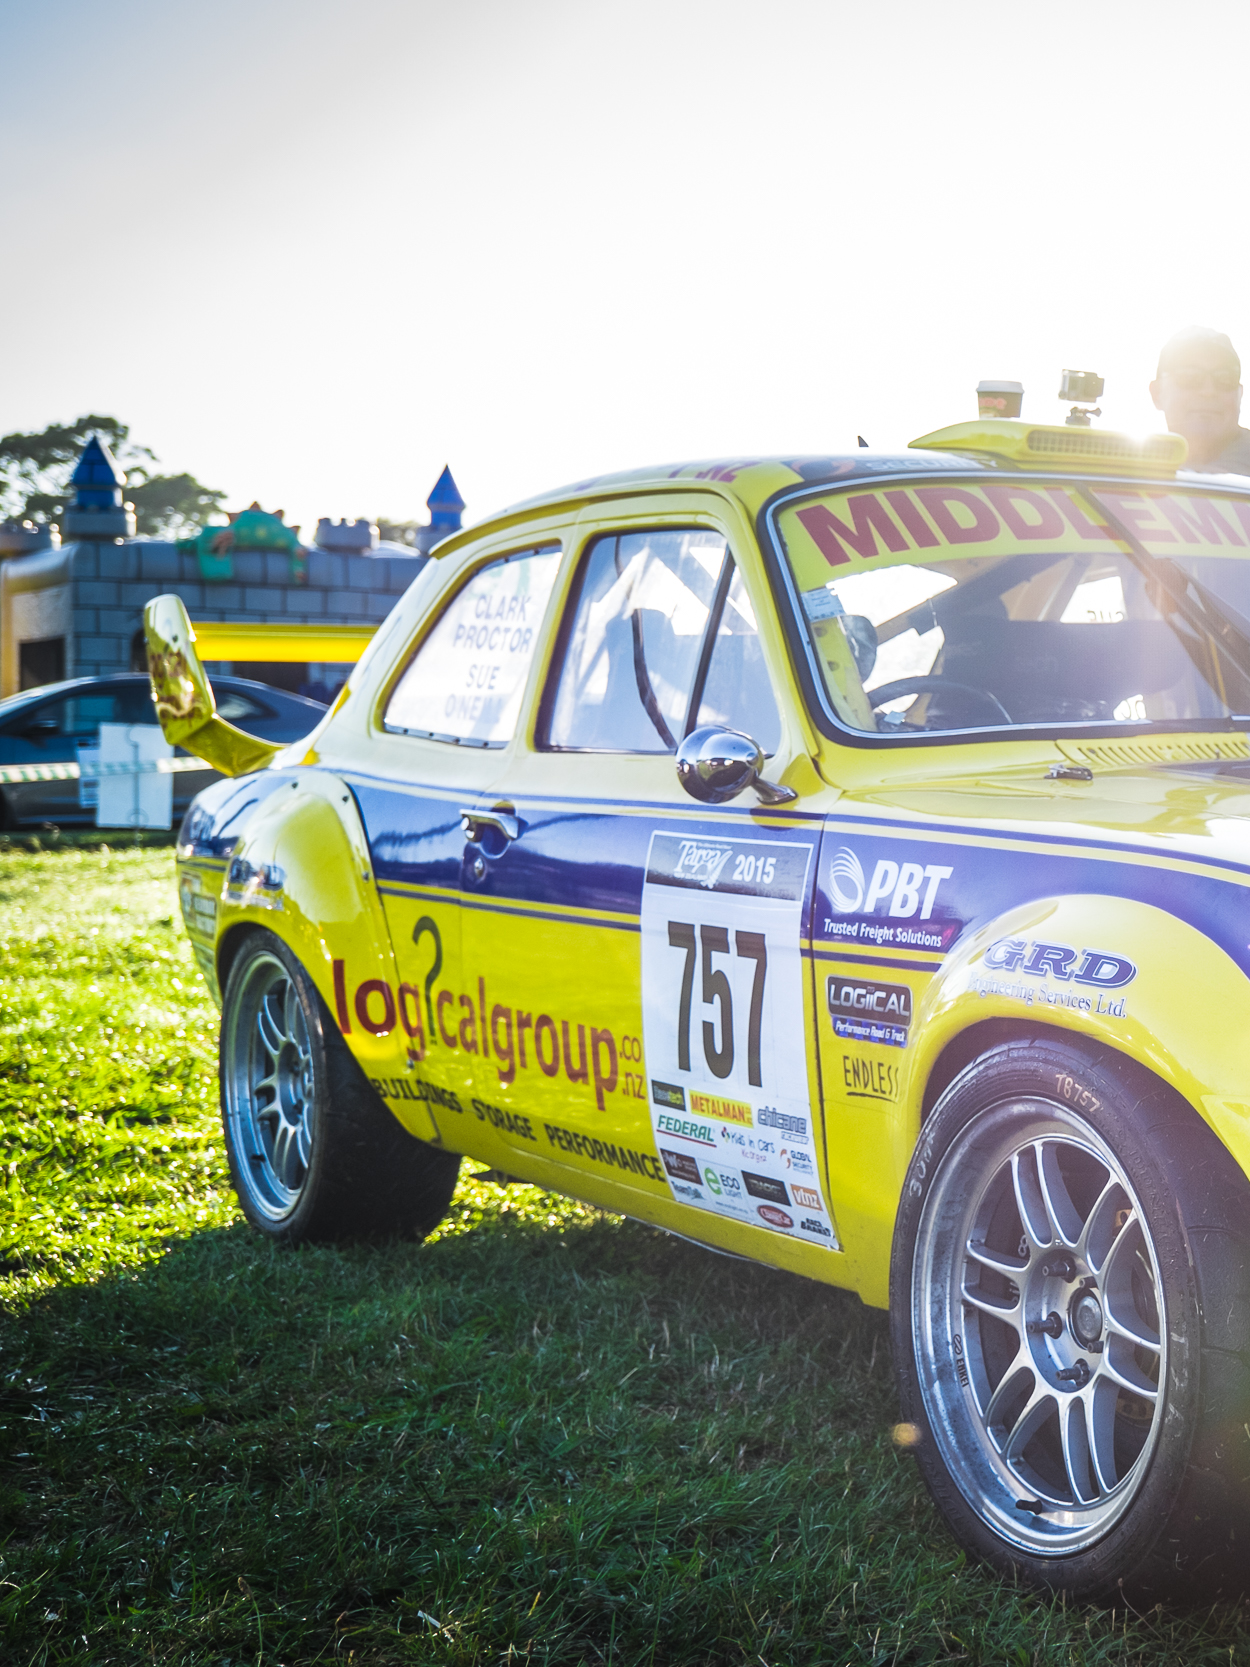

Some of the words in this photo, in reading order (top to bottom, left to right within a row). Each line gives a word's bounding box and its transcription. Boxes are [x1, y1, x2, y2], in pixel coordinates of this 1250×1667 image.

[475, 594, 531, 622] CLARK
[453, 622, 533, 654] PROCTOR
[466, 664, 500, 690] SUE
[673, 840, 728, 876] Targa
[732, 853, 776, 885] 2015
[863, 859, 954, 920] PBT
[824, 918, 858, 937] Trusted
[860, 923, 893, 944] Freight
[896, 927, 942, 947] Solutions
[983, 936, 1137, 989] GRD
[668, 921, 766, 1088] 757
[968, 971, 1035, 1006] Engineering
[1038, 982, 1092, 1011] Services
[1095, 993, 1127, 1019] Ltd.
[835, 1020, 870, 1036] Performance
[891, 1028, 905, 1042] Track
[619, 1035, 641, 1063] .co
[622, 1072, 646, 1100] .nz
[843, 1054, 899, 1098] ENDLESS
[690, 1093, 746, 1123] METALMAN
[758, 1106, 807, 1134] chicane
[369, 1078, 463, 1114] BUILDINGS
[472, 1099, 538, 1141] STORAGE
[544, 1122, 666, 1183] PERFORMANCE
[658, 1114, 715, 1142] FEDERAL
[730, 1131, 746, 1146] Kids
[757, 1139, 776, 1154] Cars
[719, 1174, 741, 1191] ECO
[793, 1188, 820, 1208] vtnz
[956, 1358, 969, 1388] ENKEI
